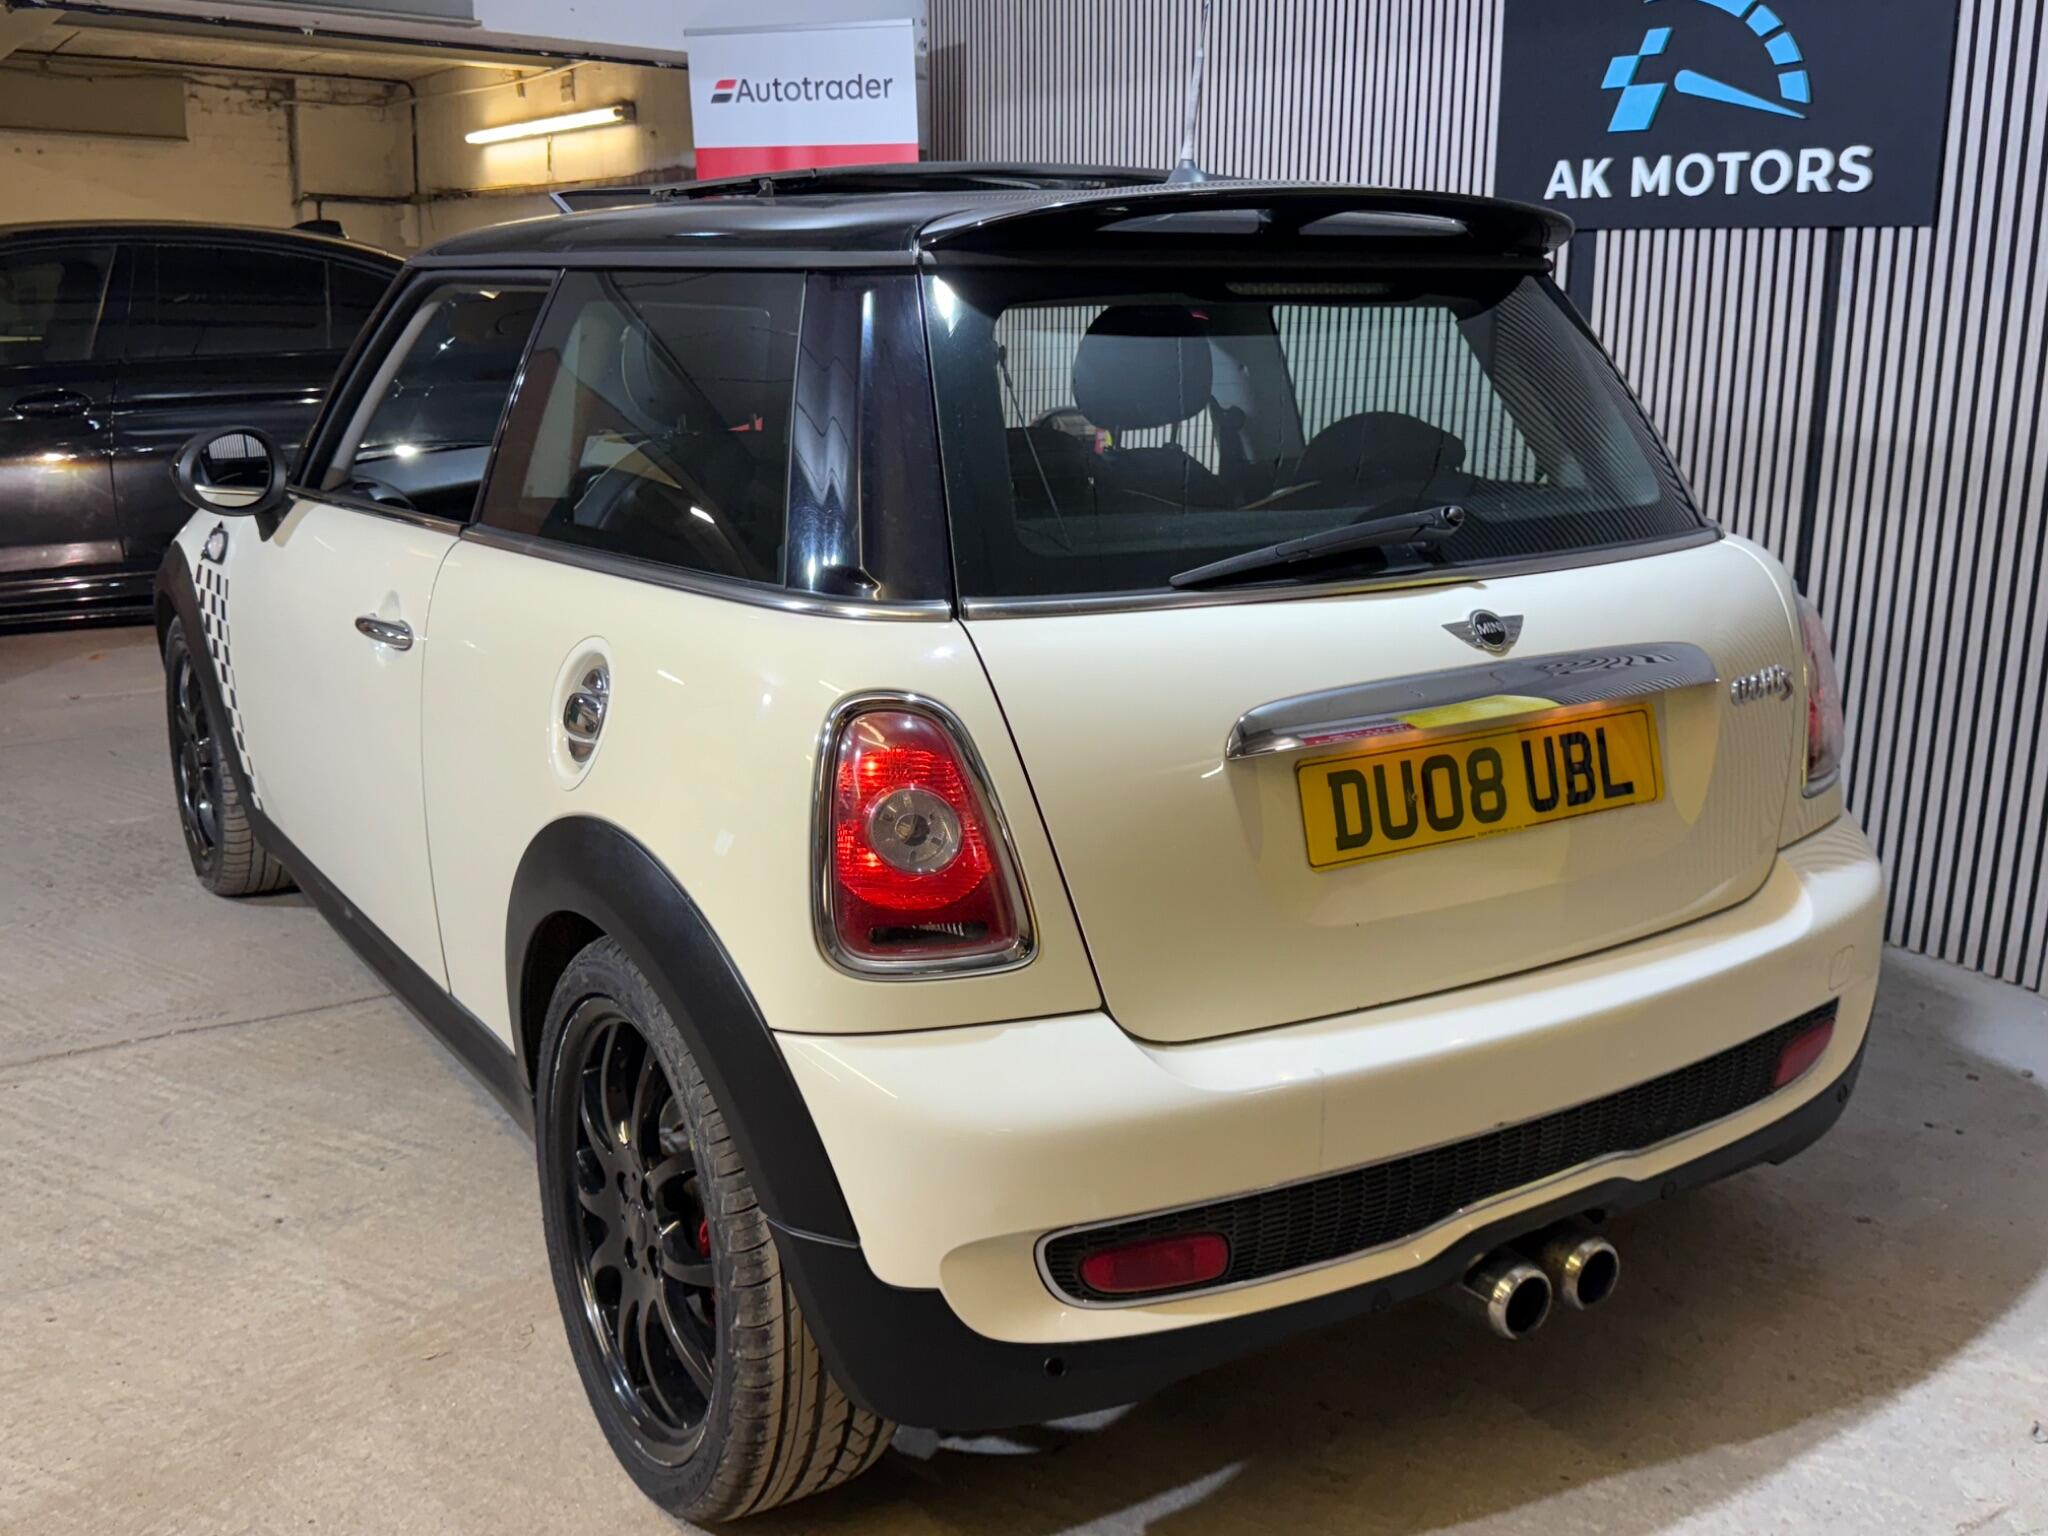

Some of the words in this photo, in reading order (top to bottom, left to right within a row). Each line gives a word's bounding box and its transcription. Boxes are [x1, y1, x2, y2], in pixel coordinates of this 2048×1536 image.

[735, 73, 893, 103] Autotrader
[1544, 157, 1613, 200] AK
[1630, 145, 1874, 198] MOTORS
[1327, 747, 1507, 851] DU08
[1521, 727, 1635, 813] UBL
